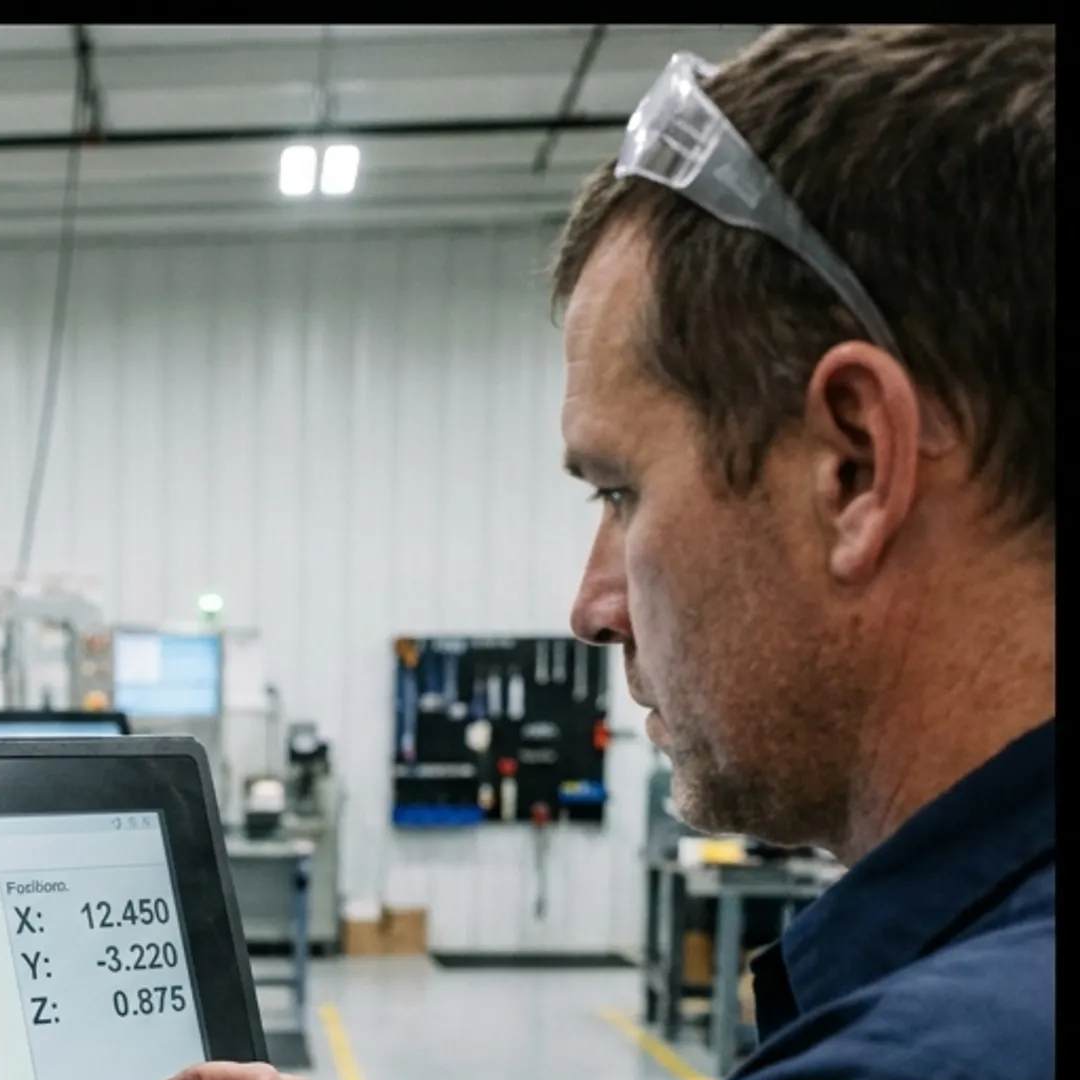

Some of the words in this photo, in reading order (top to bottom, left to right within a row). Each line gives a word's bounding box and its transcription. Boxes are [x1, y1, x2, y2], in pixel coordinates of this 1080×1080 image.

[13, 905, 45, 935] X:
[80, 897, 170, 930] 12.450
[21, 951, 52, 980] Y:
[96, 941, 178, 974] -3.220
[30, 996, 60, 1025] Z:
[113, 985, 186, 1017] 0.875
